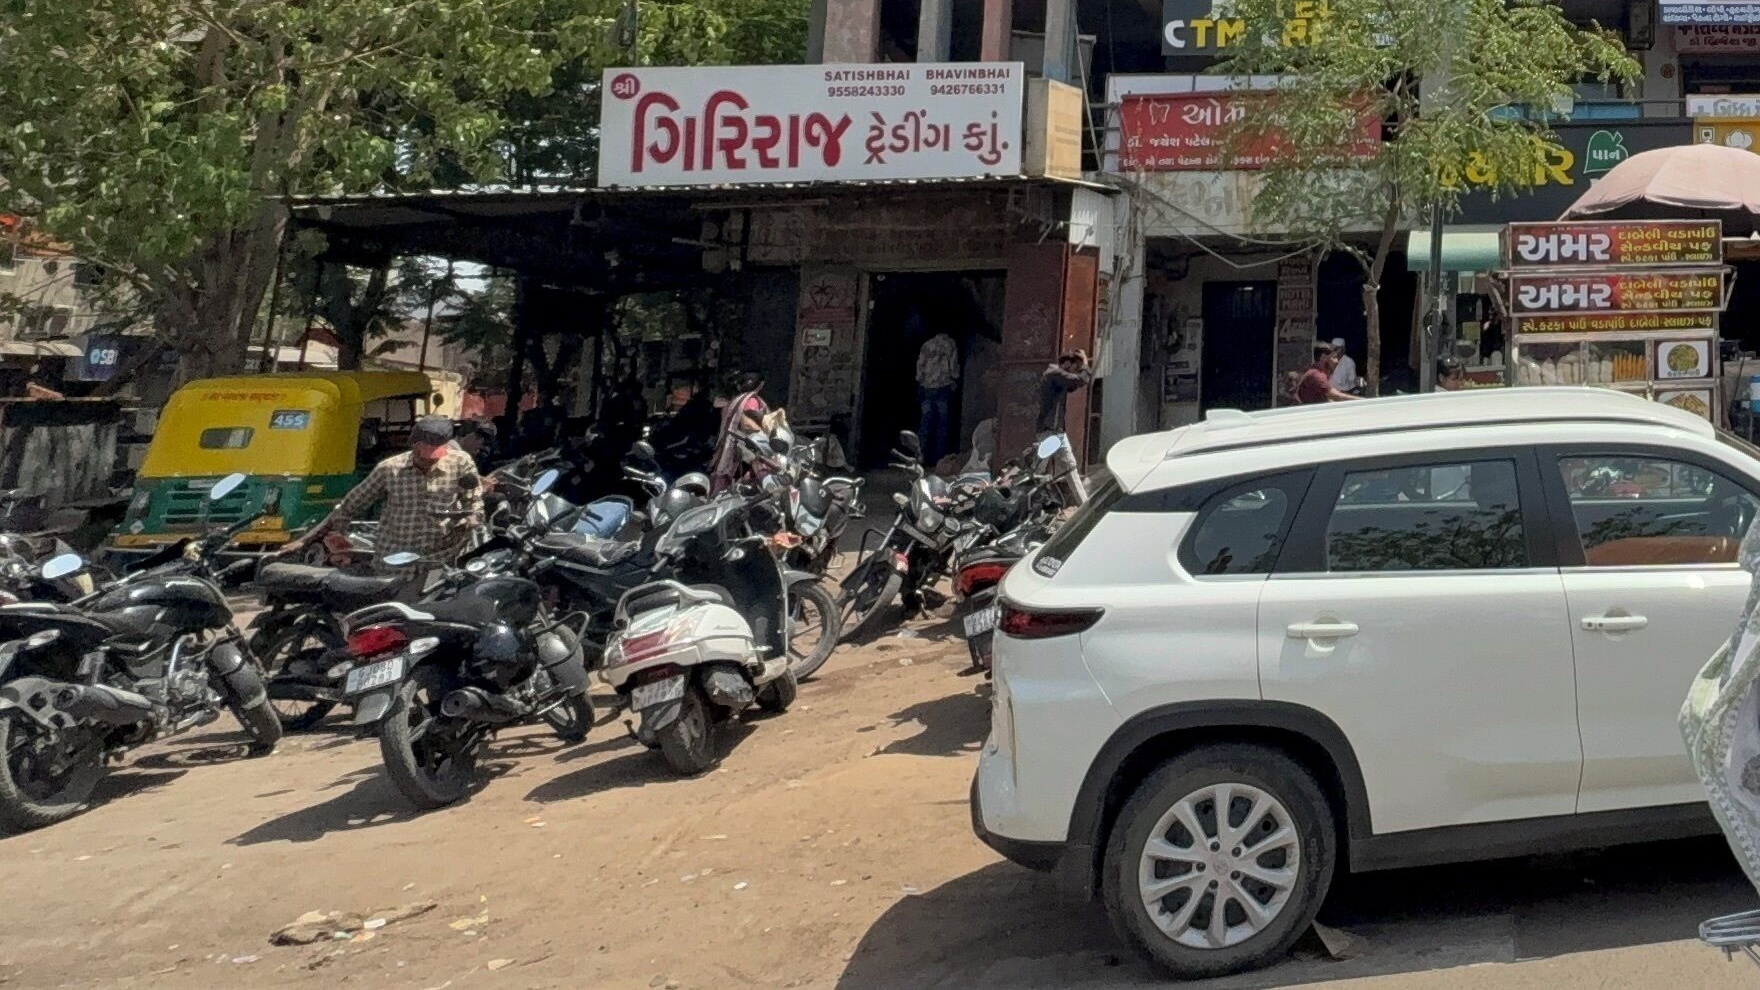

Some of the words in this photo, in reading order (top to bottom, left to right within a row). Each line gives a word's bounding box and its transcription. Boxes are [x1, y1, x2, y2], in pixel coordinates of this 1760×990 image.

[825, 70, 910, 82] SATISHBHAI
[926, 68, 1010, 80] BHAVINBHAI
[828, 85, 905, 97] 9558243330
[930, 84, 1005, 95] 9426766331
[631, 89, 853, 173] ગિરિરાજ
[1592, 149, 1621, 160] પાન
[1618, 228, 1661, 240] દાબેલી
[1518, 233, 1610, 261] અમર
[1518, 284, 1612, 309] અમર
